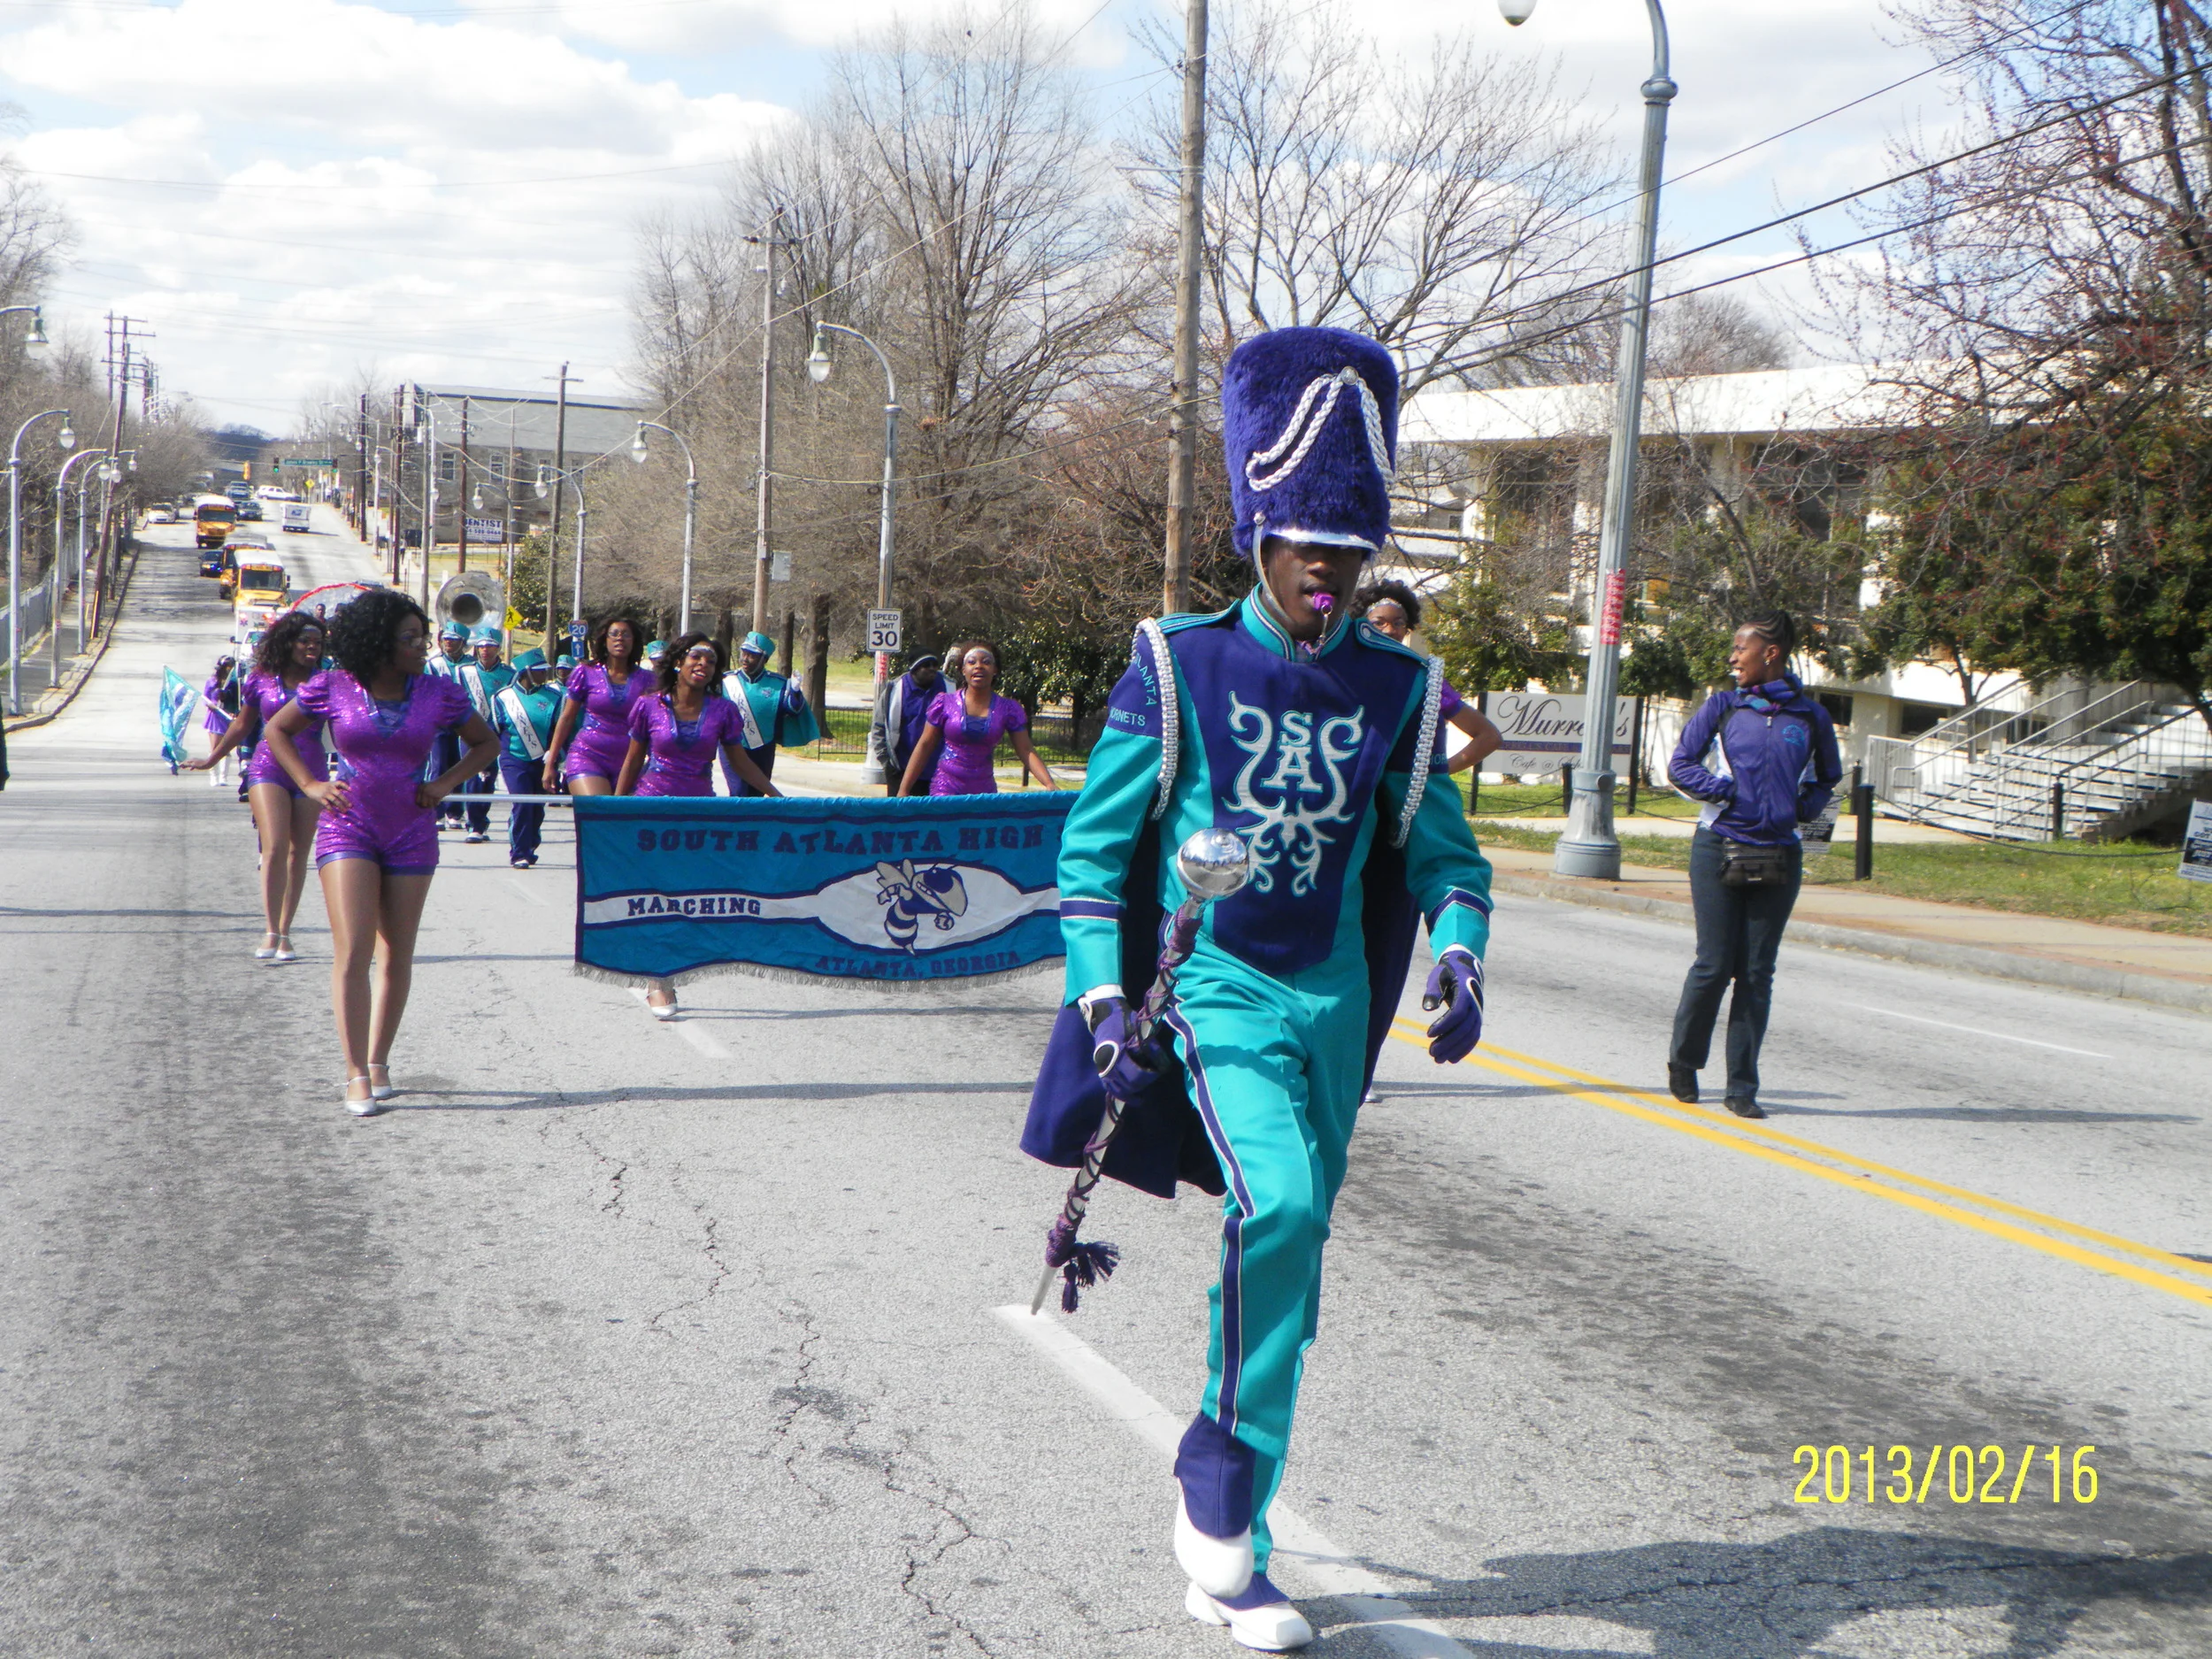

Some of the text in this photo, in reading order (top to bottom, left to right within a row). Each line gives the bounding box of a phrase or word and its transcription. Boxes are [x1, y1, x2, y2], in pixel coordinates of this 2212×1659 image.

[572, 625, 586, 635] 20
[872, 630, 898, 647] 30
[1498, 695, 1629, 737] Murre's
[1509, 752, 1537, 772] Cafe
[637, 828, 760, 852] SOUTH
[773, 829, 943, 855] ATLANTA
[958, 824, 1043, 850] HIGH
[627, 896, 761, 917] MARCHING
[931, 950, 1021, 975] GEORGIA
